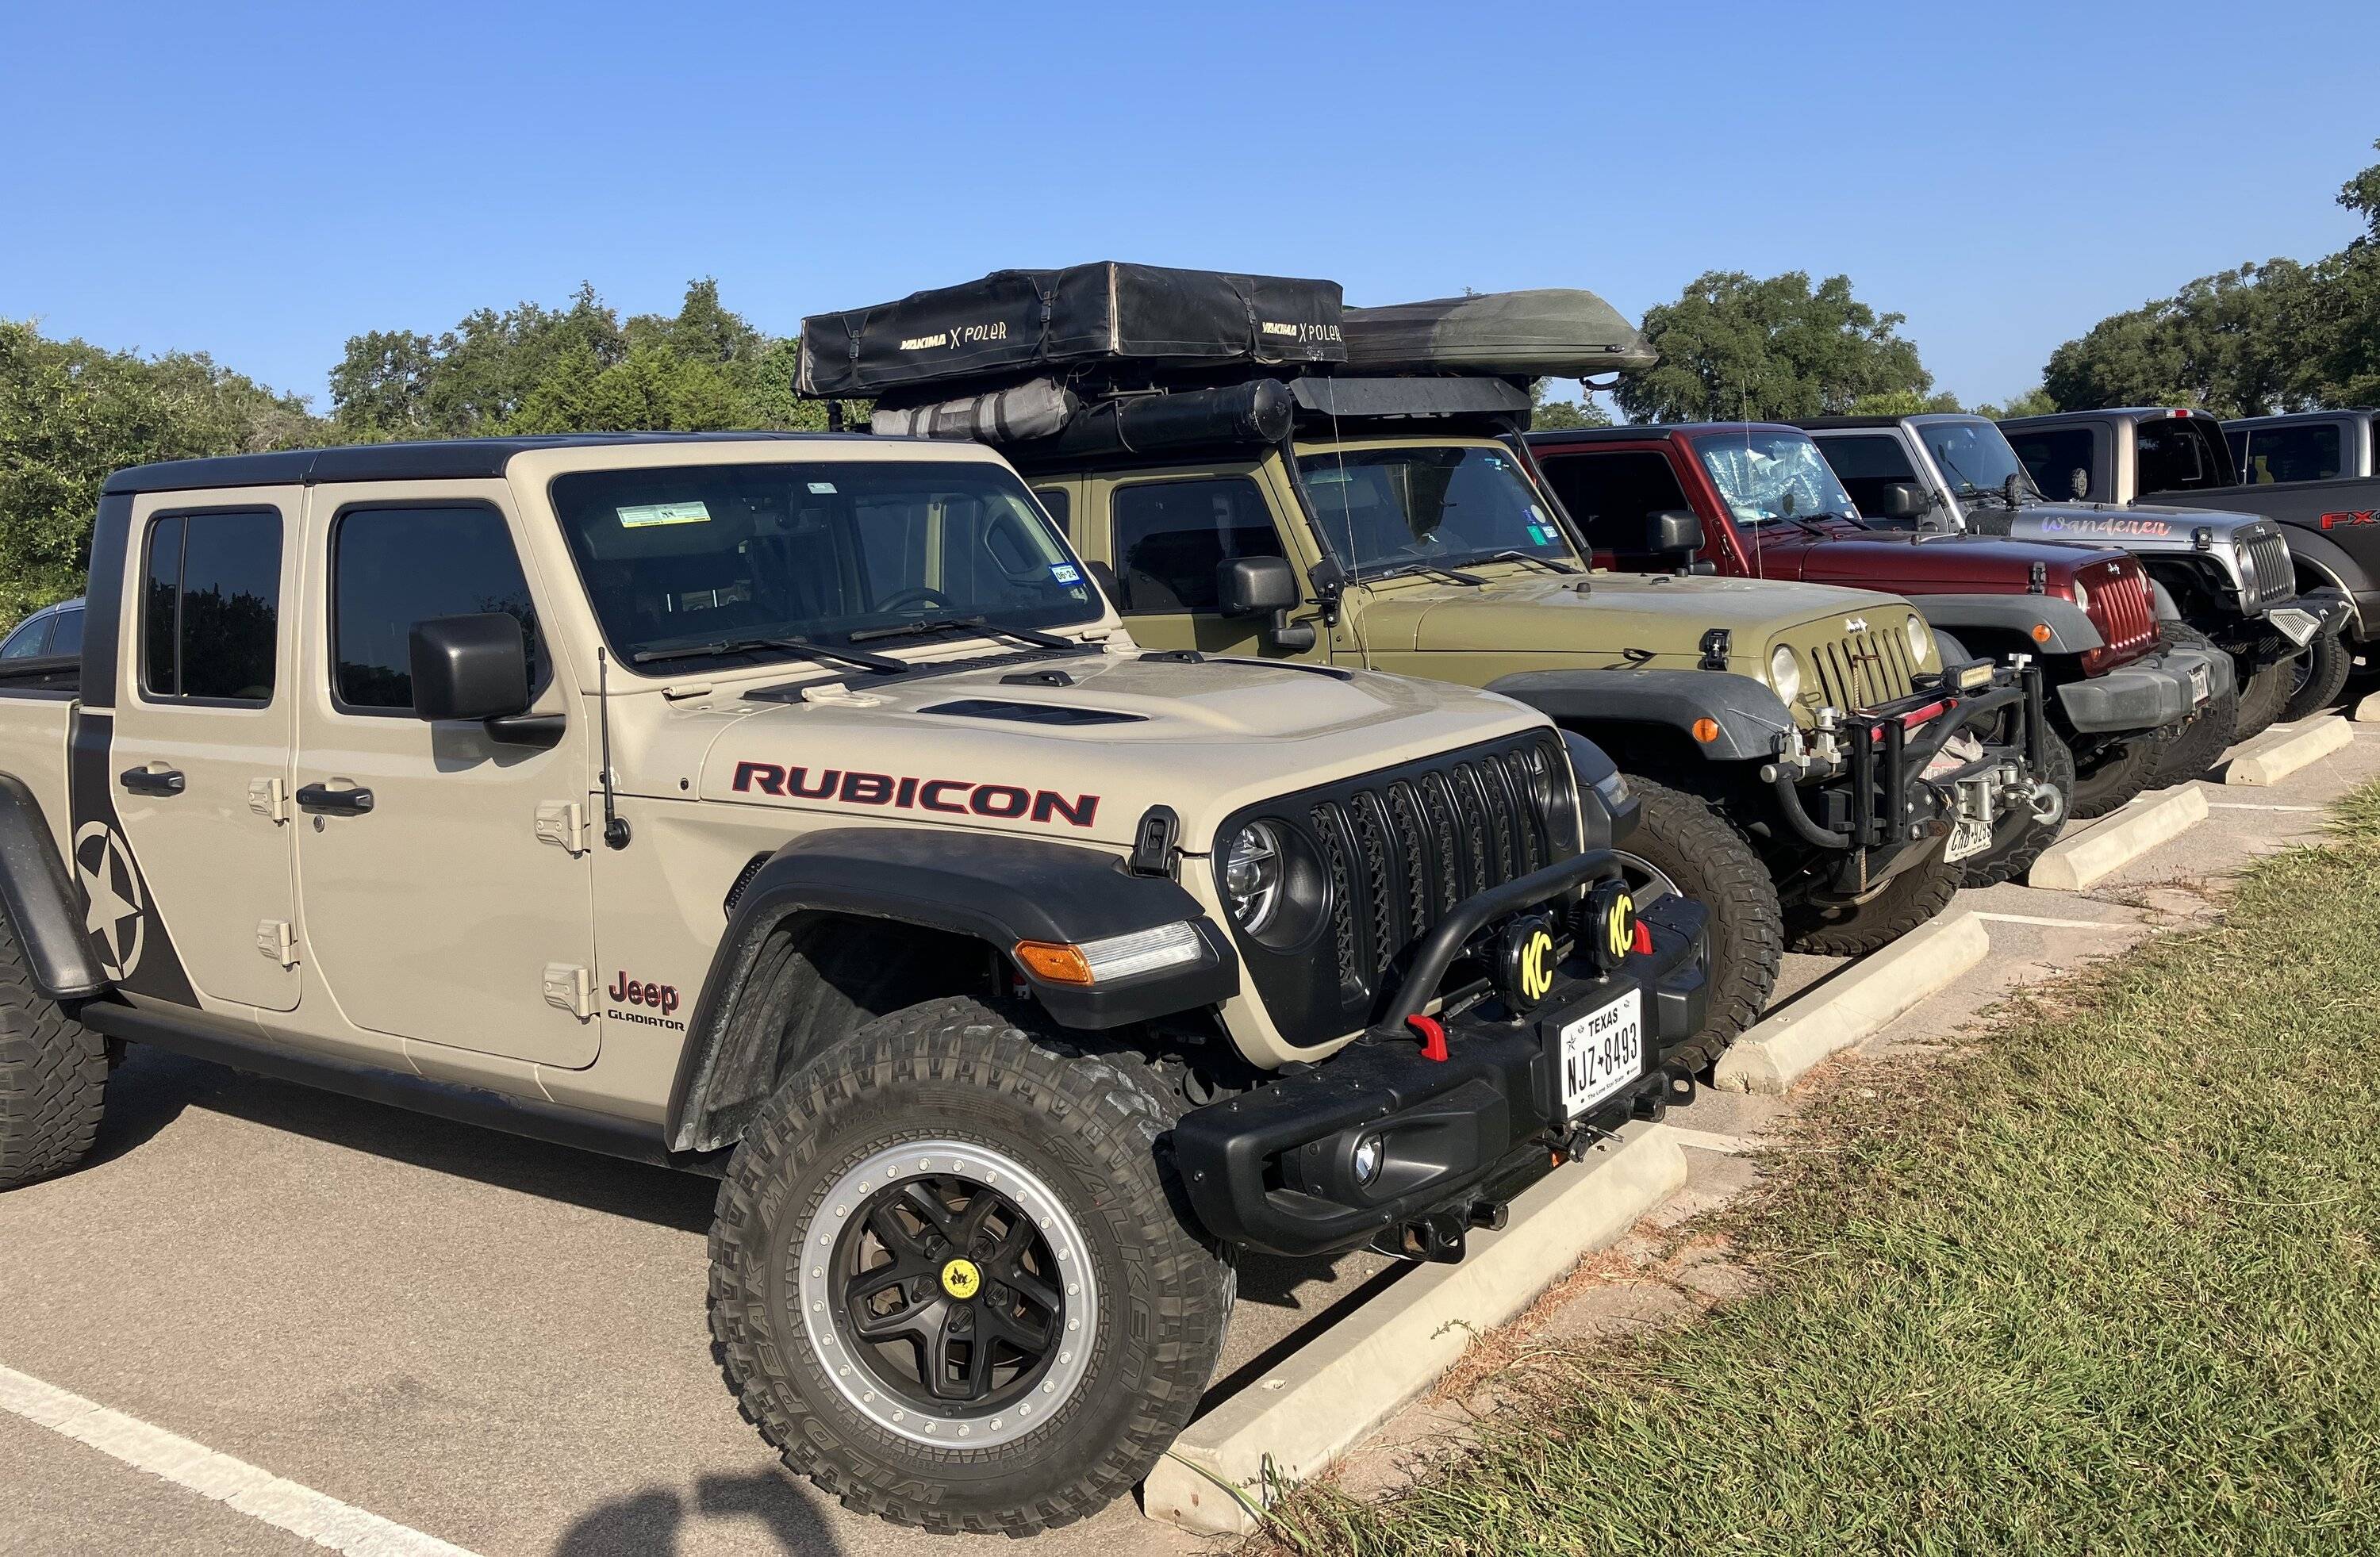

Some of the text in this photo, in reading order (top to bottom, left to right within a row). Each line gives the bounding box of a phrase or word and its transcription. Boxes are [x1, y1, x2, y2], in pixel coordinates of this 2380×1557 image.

[900, 334, 946, 350] YAKIMA
[950, 327, 962, 350] X
[1262, 322, 1297, 336] YAKIMA
[1299, 323, 1307, 343] X
[2320, 509, 2380, 531] FX
[732, 761, 1101, 828] RUBICON
[1610, 893, 1633, 958] KC
[1522, 930, 1553, 1000] KC
[608, 970, 679, 1016] Jeep
[608, 1008, 685, 1032] GLADIATOR
[1588, 1007, 1618, 1037] TEXAS
[744, 1251, 949, 1505] WILDPEAK
